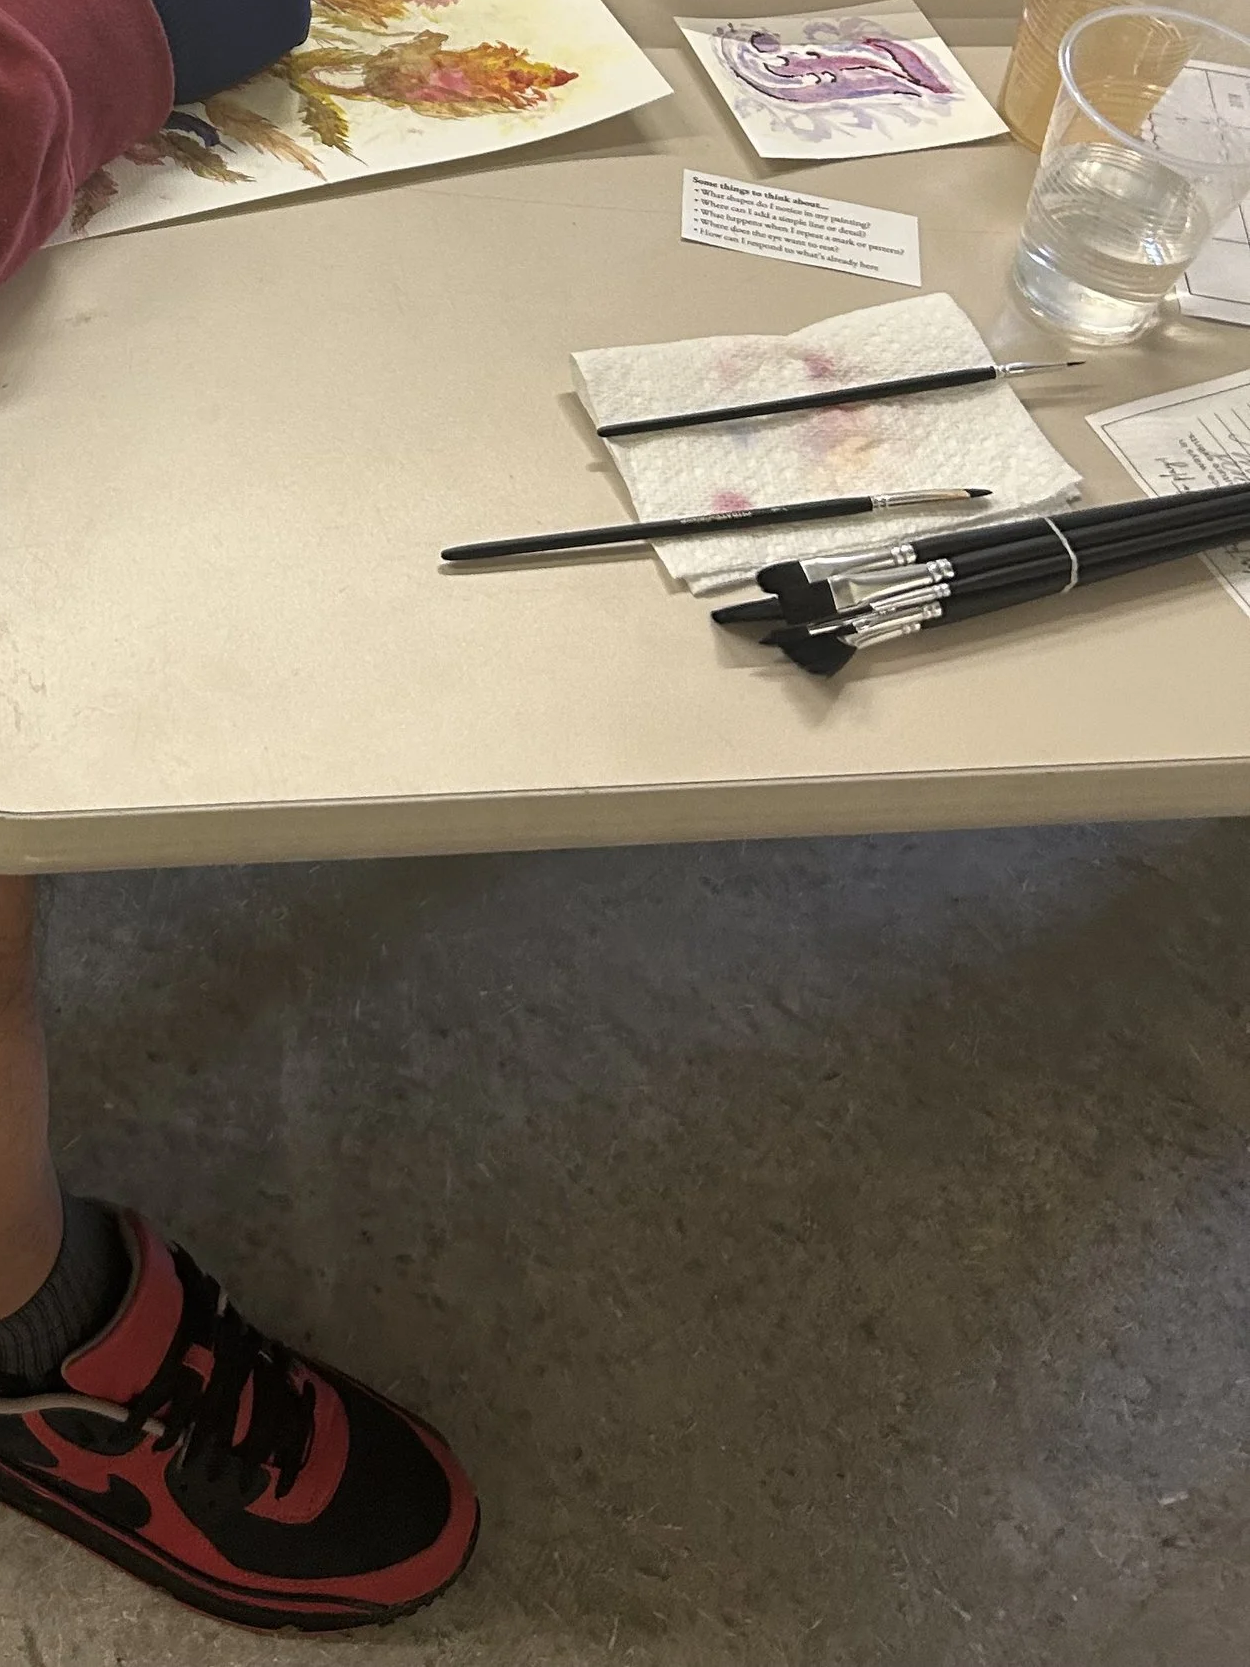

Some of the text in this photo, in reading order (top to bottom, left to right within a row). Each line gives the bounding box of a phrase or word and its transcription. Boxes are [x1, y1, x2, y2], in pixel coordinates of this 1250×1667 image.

[692, 176, 830, 211] Some things to think about...
